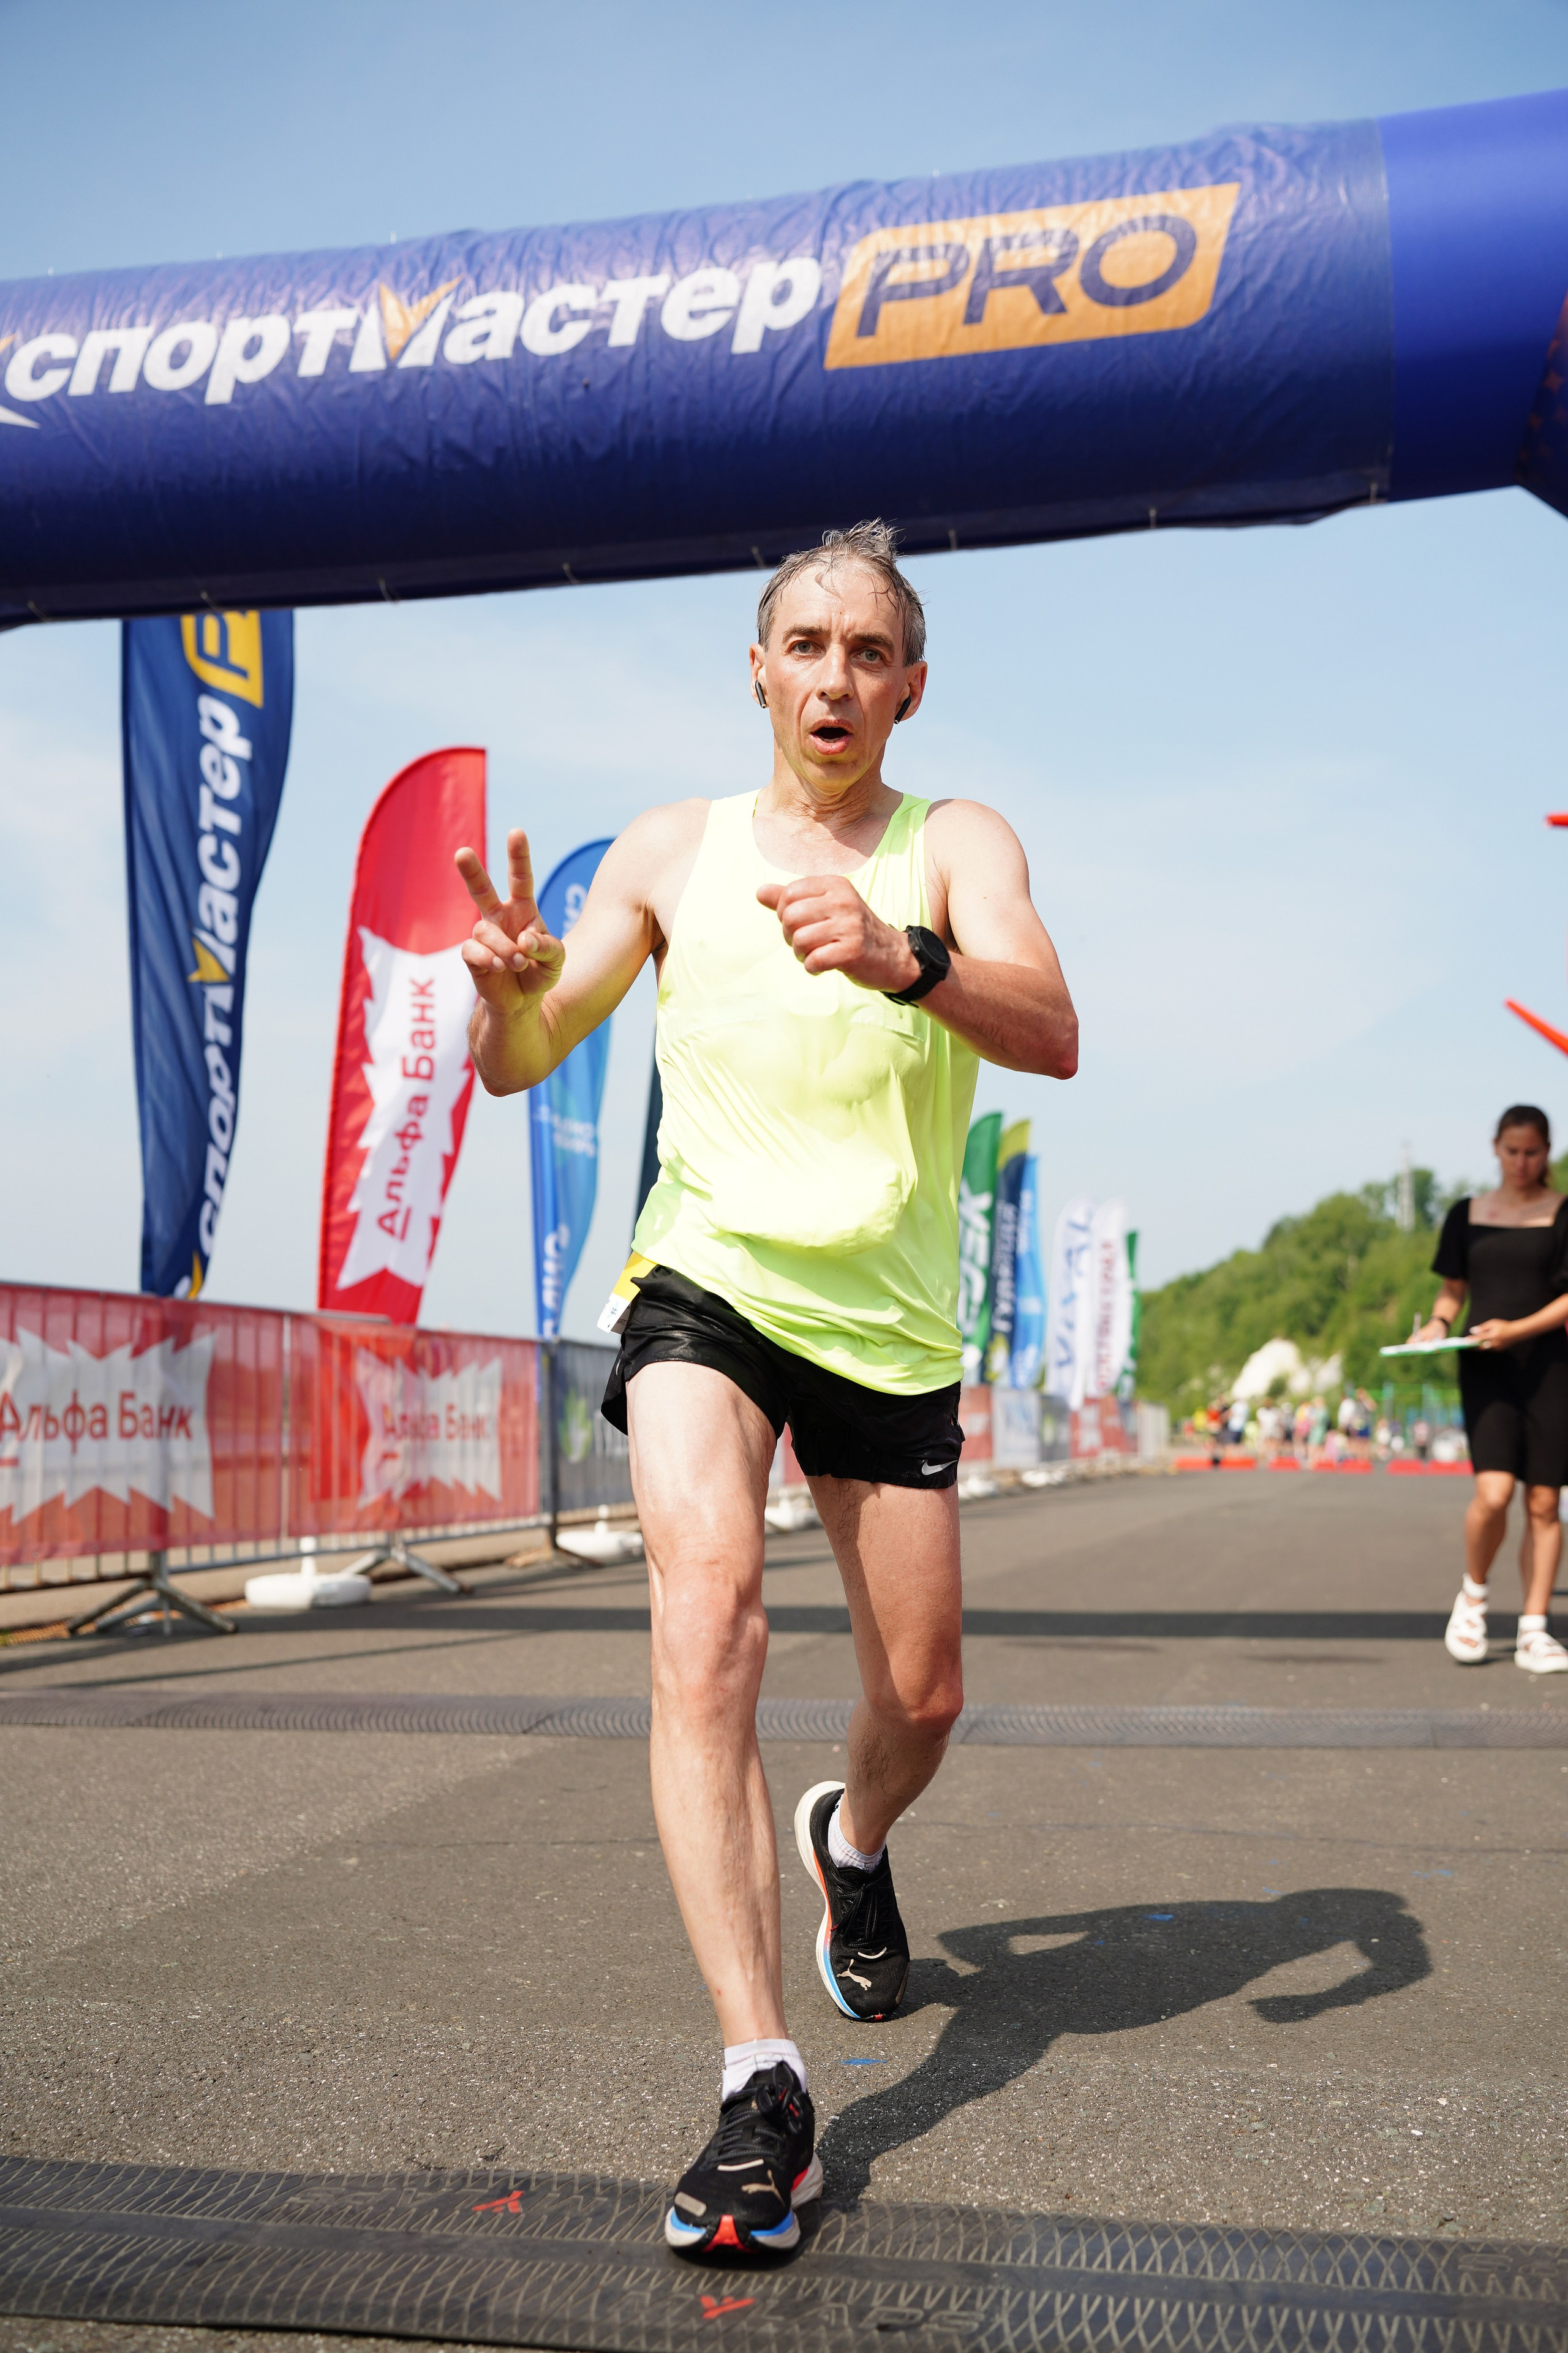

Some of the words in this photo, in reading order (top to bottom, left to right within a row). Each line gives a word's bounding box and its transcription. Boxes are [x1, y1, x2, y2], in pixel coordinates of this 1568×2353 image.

[855, 214, 1197, 339] PRO
[401, 976, 435, 1081] Банк
[376, 1094, 428, 1242] Альфа
[0, 1389, 108, 1457] Альфа
[118, 1389, 194, 1441] Банк
